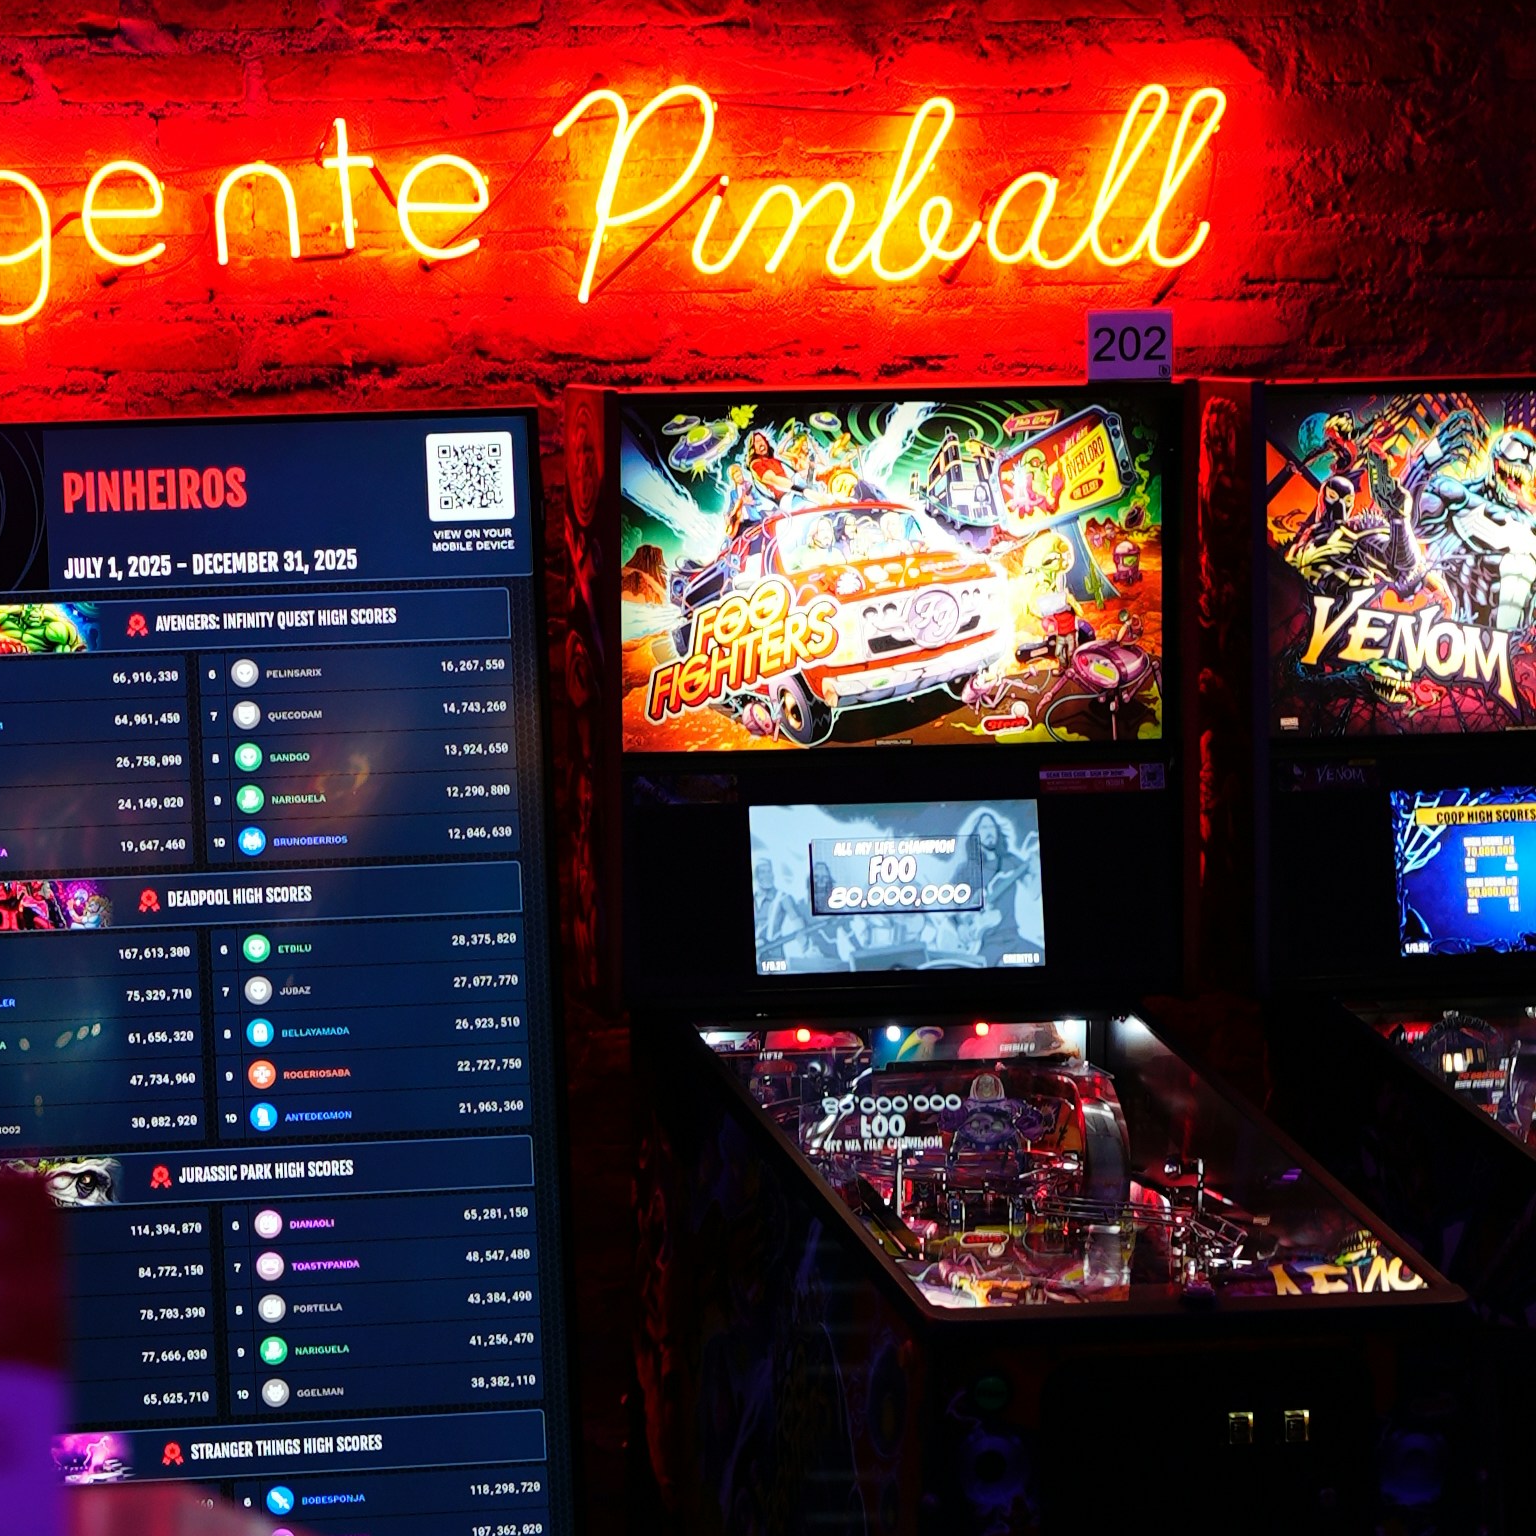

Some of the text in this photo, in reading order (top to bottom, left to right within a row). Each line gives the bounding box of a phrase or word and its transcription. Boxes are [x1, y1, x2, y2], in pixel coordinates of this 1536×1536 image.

[551, 82, 1228, 303] Pinball
[1092, 325, 1167, 362] 202
[1066, 436, 1105, 481] OVERLORD
[63, 467, 247, 513] PINHEIROS
[434, 528, 512, 539] VIEW ON YOUR
[433, 540, 514, 551] MOBILE DEVICE
[64, 557, 103, 579] JULY
[108, 557, 122, 581] 1,
[128, 555, 171, 577] 2025
[193, 551, 279, 574] DECEMBER
[284, 551, 309, 574] 31,
[314, 549, 357, 570] 2025
[156, 608, 396, 631] AVENGERS: INFINITY QUEST HIGH SCORES
[695, 577, 792, 657] FOO
[1300, 587, 1518, 710] VENOM
[648, 600, 840, 722] FIGHTERS
[267, 659, 504, 678] PELINSARIX 16,267,550
[113, 671, 178, 683] 66,916,330
[268, 701, 506, 722] QUECODAM 14,743,260
[115, 713, 180, 726] 64,961,450
[445, 743, 508, 756] 13,924,650
[117, 755, 181, 768] 26,758,090
[272, 785, 510, 803] NARIGUELA 12,290,800
[118, 797, 183, 810] 24,149,020
[1436, 808, 1536, 824] COOP HIGH SCORES
[449, 827, 511, 839] 12,046,630
[121, 839, 185, 852] 19,647,460
[833, 838, 956, 856] ALL MY LIFE CHAMPION
[868, 855, 917, 885] FOO
[168, 886, 311, 907] DEADPOOL HIGH SCORES
[827, 882, 971, 910] 80,000,000
[452, 933, 516, 946] 28,375,820
[119, 946, 190, 959] 167,613,300
[454, 975, 518, 988] 27,077,770
[127, 989, 191, 1002] 75,329,710
[456, 1017, 520, 1029] 26,923,510
[129, 1031, 193, 1044] 61,656,320
[458, 1059, 521, 1071] 22,727,750
[130, 1073, 195, 1086] 47,734,960
[459, 1101, 523, 1113] 21,963,360
[132, 1115, 197, 1128] 30,082,920
[179, 1160, 353, 1183] JURASSIC PARK HIGH SCORES
[464, 1207, 528, 1220] 65,281,150
[131, 1223, 201, 1236] 114,394,870
[292, 1249, 530, 1270] TOASTYPANDA 48,547,480
[139, 1265, 203, 1278] 84,772,150
[294, 1291, 532, 1312] PORTELLA 43,384,490
[140, 1307, 205, 1320] 78,703,390
[296, 1333, 533, 1355] NARIGUELA 41,256,470
[142, 1349, 207, 1362] 77,666,030
[472, 1375, 535, 1388] 38,382,110
[144, 1392, 209, 1405] 65,625,710
[191, 1435, 382, 1459] STRANGER THINGS HIGH SCORES
[471, 1482, 540, 1495] 118,298,720
[473, 1524, 542, 1536] 107,362,020
